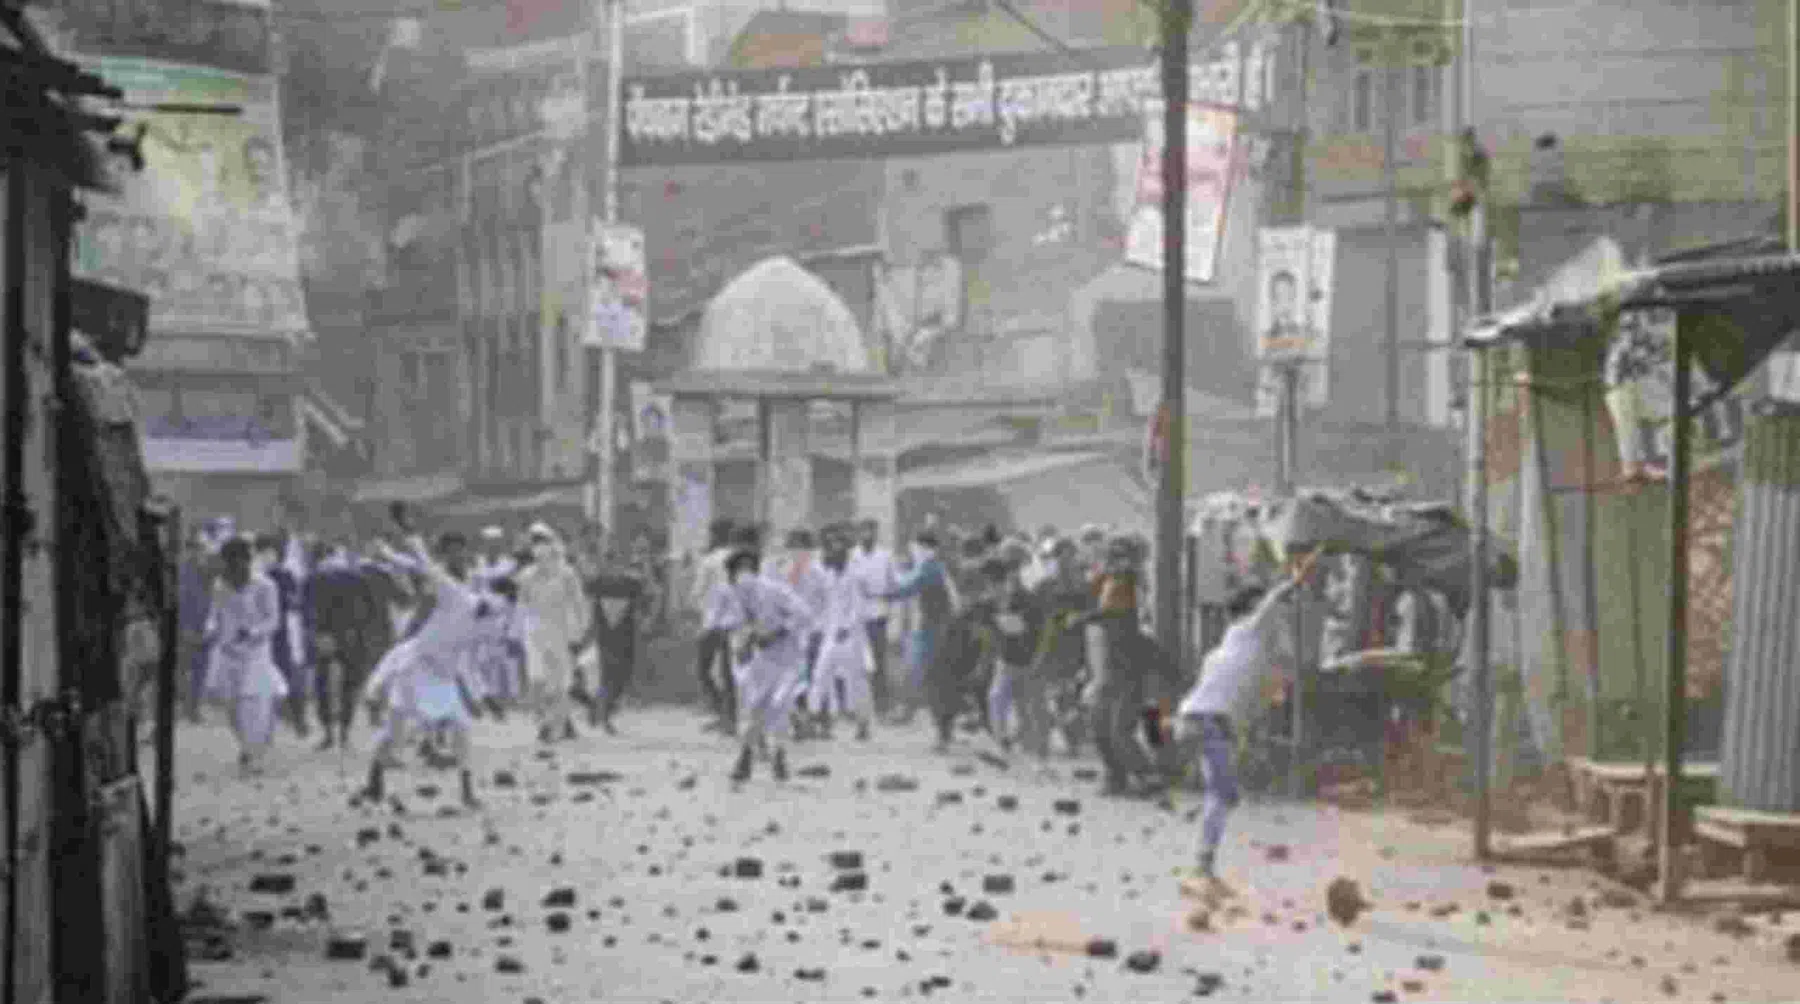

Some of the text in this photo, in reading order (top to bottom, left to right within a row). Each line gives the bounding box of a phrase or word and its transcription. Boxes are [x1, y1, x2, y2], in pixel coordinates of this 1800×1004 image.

[924, 66, 949, 128] के
[952, 60, 995, 128] सभी
[999, 71, 1093, 145] दुकानदार
